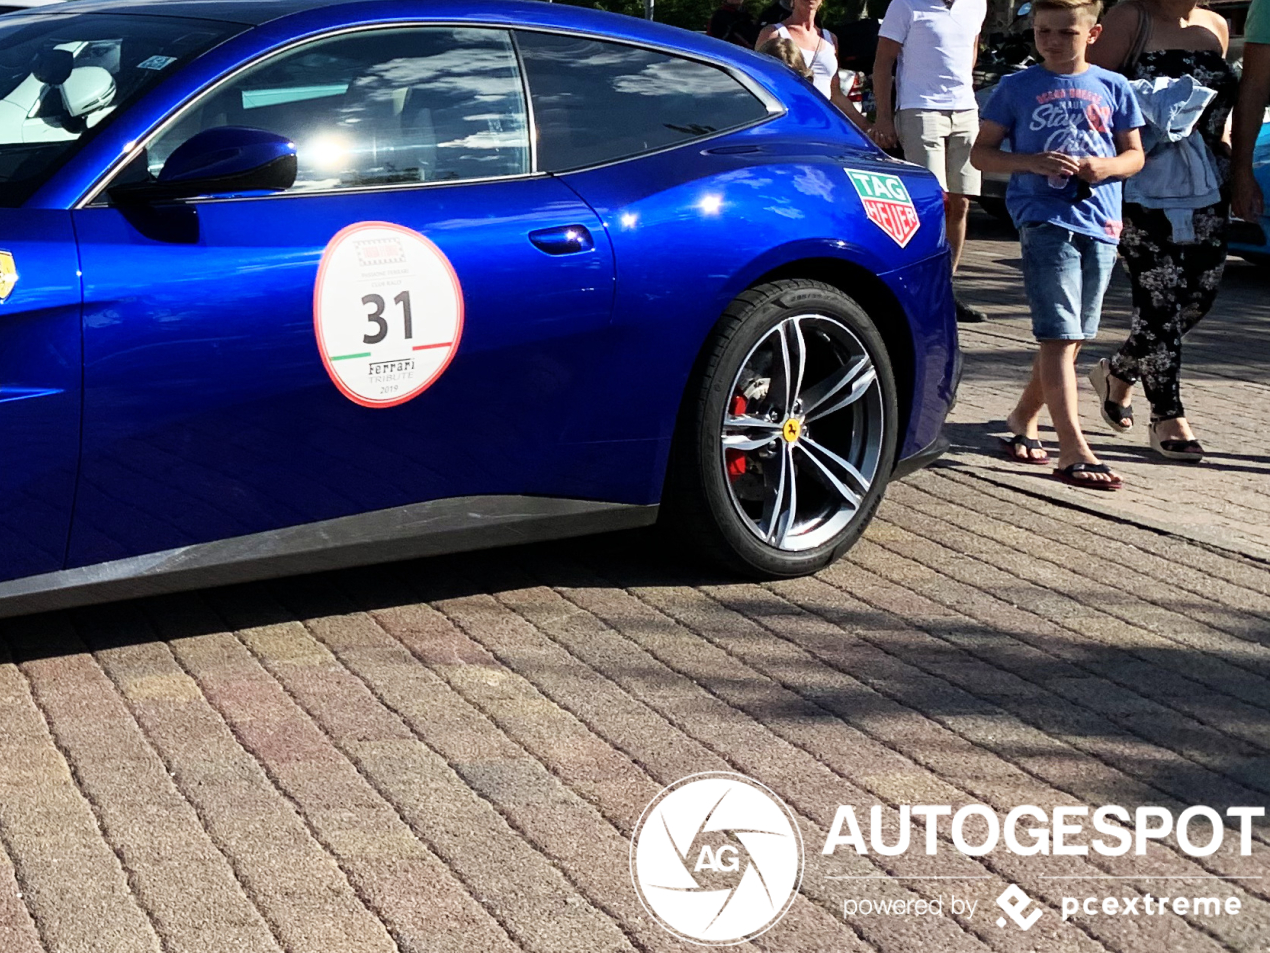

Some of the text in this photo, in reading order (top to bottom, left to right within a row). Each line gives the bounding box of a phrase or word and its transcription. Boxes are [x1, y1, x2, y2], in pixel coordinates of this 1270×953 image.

[1030, 103, 1086, 131] Stay
[851, 173, 906, 200] TAG
[866, 201, 917, 241] HEUER
[361, 290, 413, 345] 31
[368, 358, 415, 375] Ferrari
[368, 371, 414, 384] TRIBUTE
[380, 384, 398, 394] 2019
